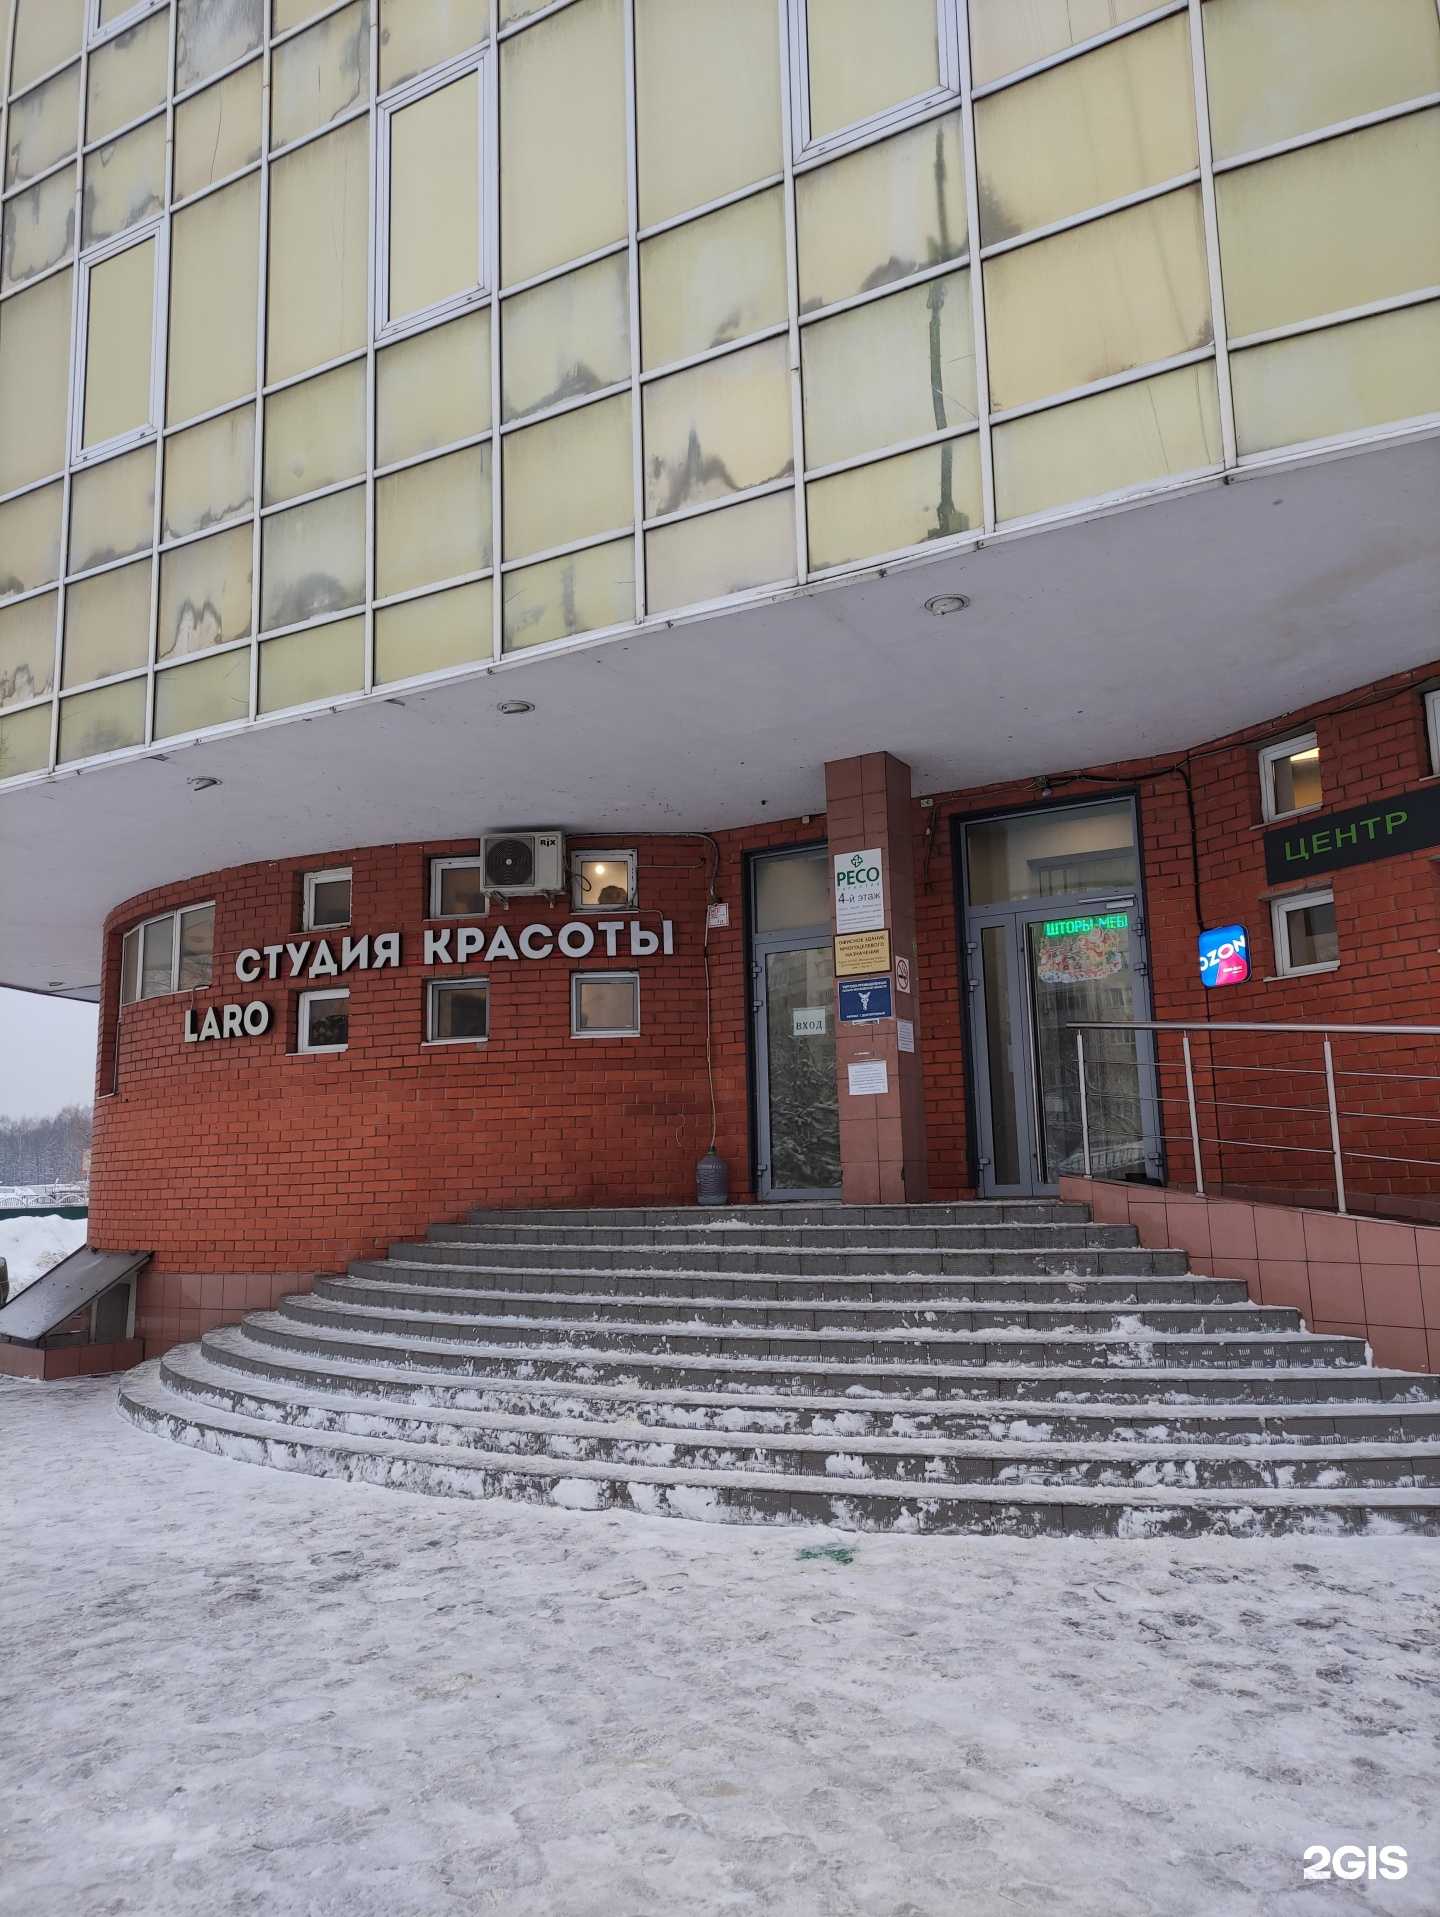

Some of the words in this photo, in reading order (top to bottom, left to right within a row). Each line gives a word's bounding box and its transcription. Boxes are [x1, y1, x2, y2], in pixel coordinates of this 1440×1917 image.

[1284, 811, 1408, 861] ЦЕНТР
[837, 867, 880, 887] РЕСО
[858, 892, 880, 902] этаж
[1046, 919, 1094, 936] ШТОРЫ
[235, 932, 400, 983] СТУДИЯ
[423, 919, 674, 965] КРАСОТЫ
[1200, 935, 1246, 972] OZON
[184, 1001, 270, 1043] LARO
